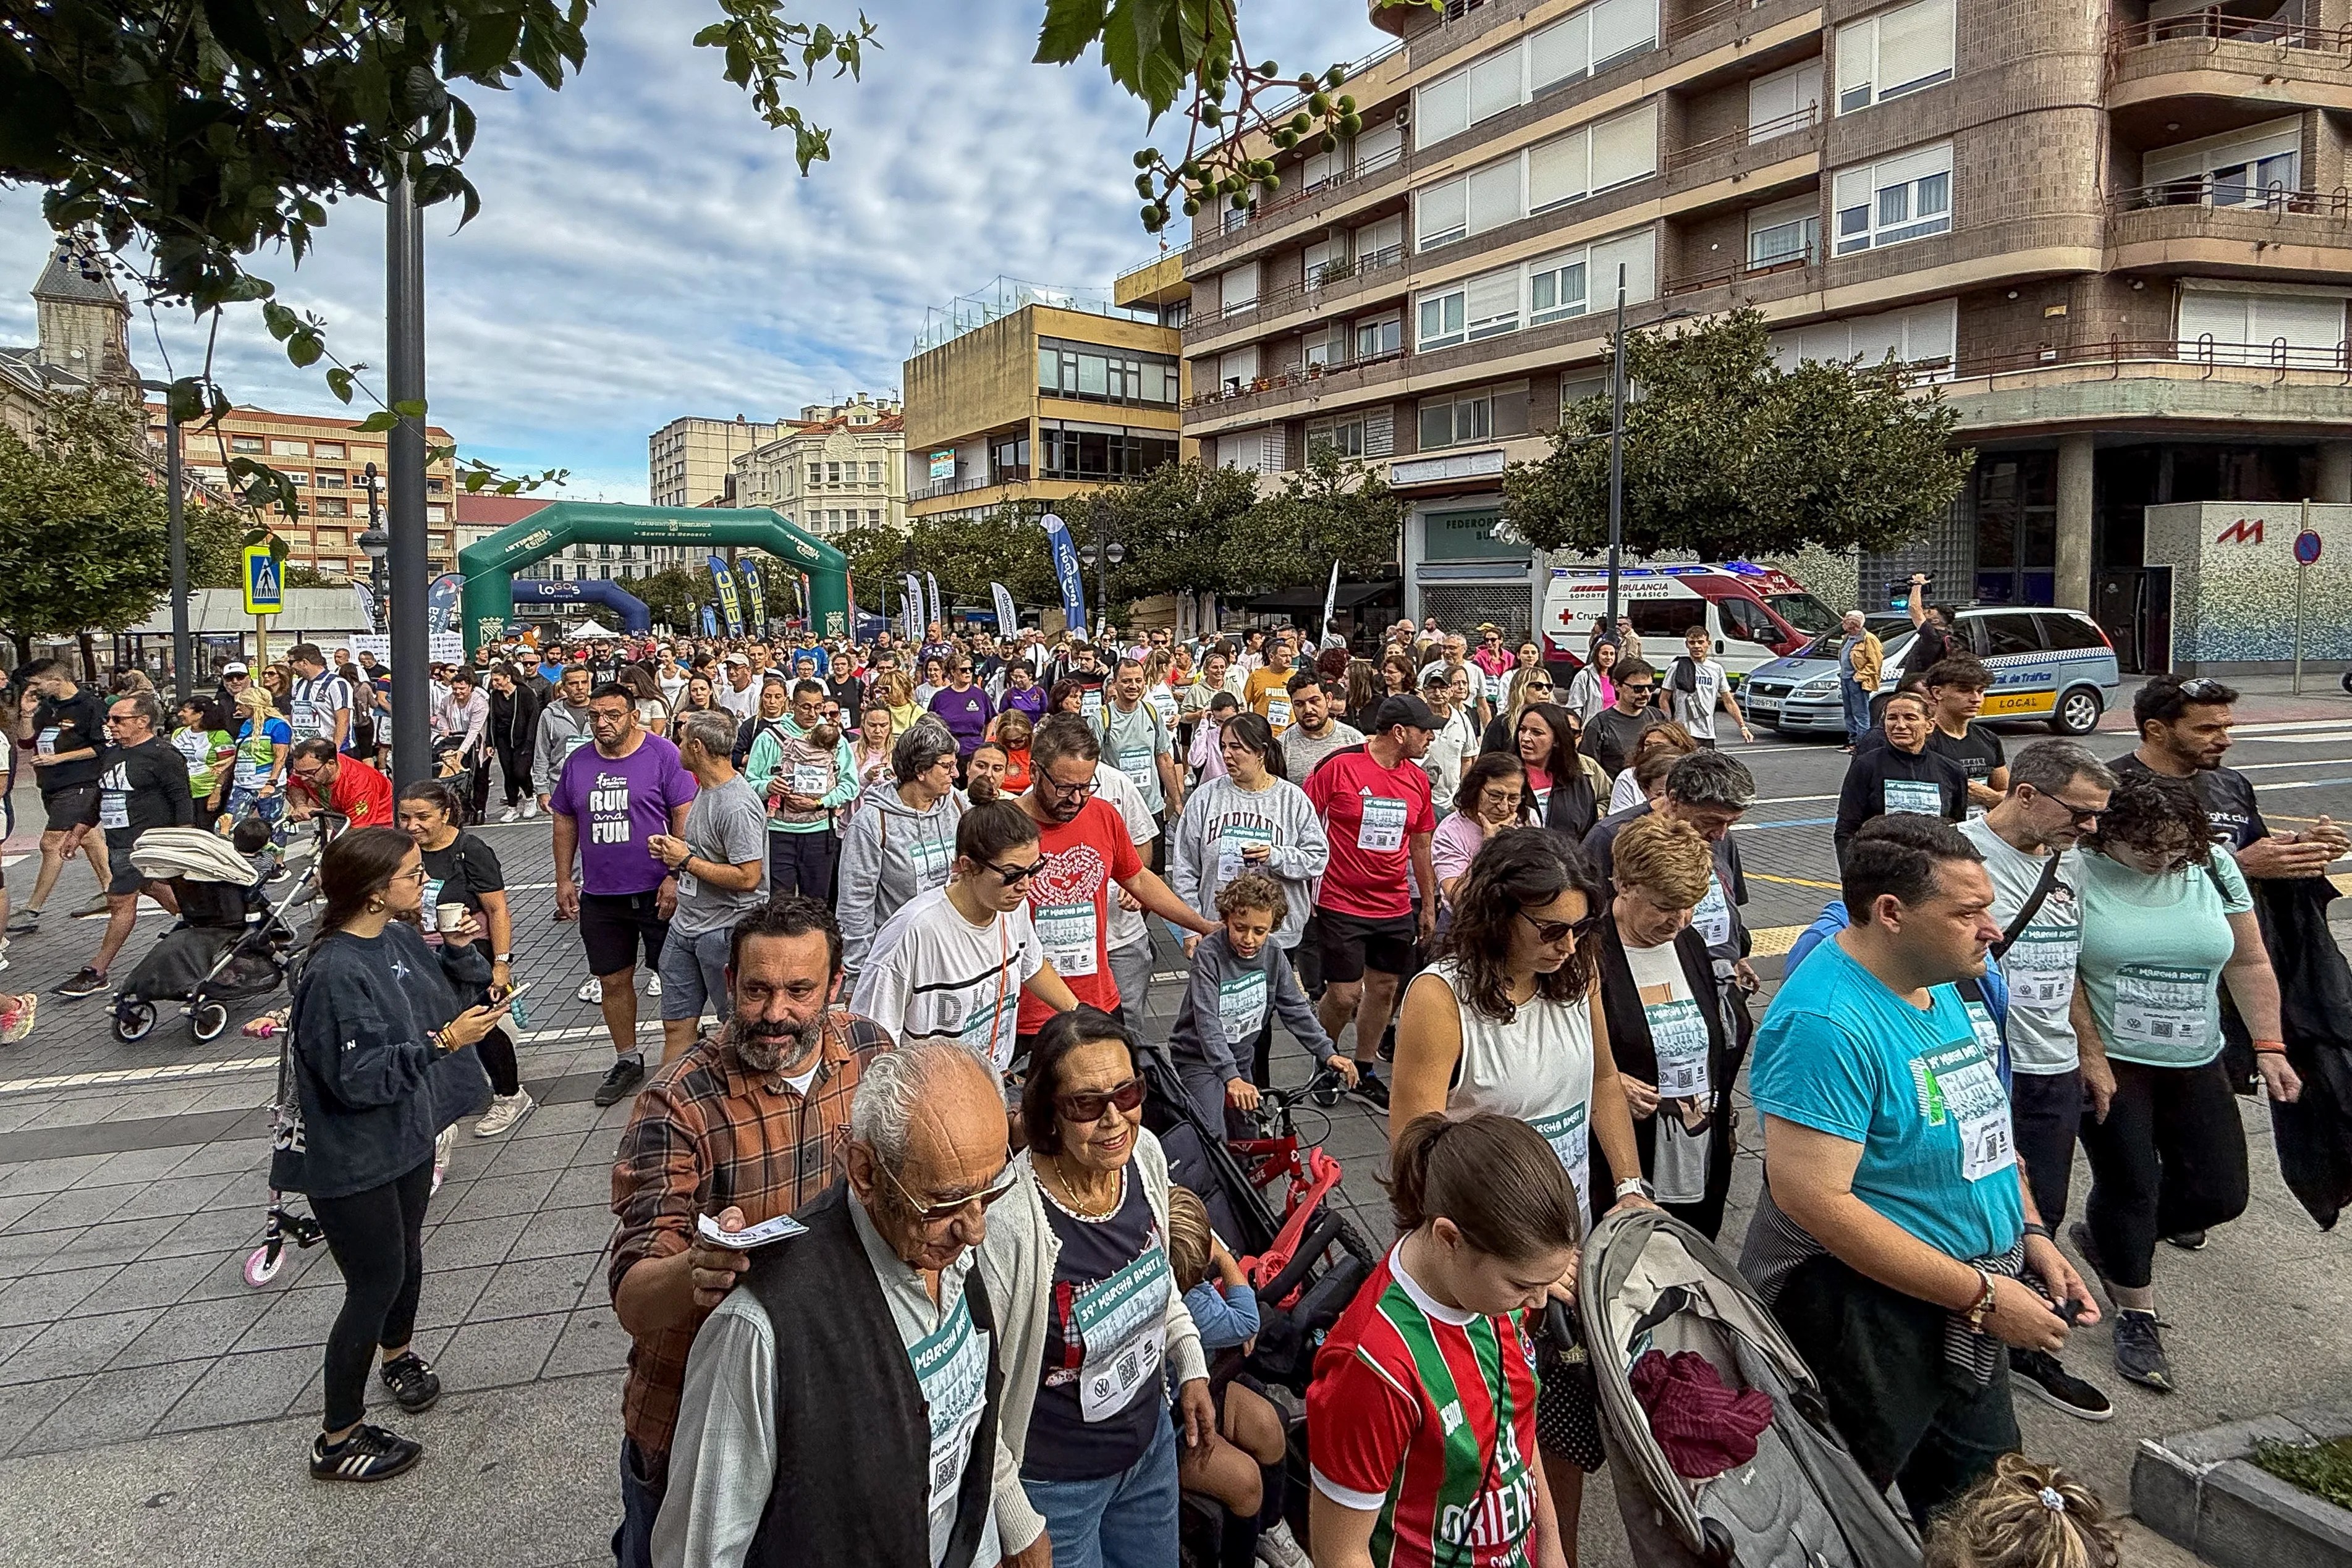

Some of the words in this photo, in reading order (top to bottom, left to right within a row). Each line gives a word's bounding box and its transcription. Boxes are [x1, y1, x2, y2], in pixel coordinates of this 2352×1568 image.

[1999, 698, 2037, 708] LOCAL
[590, 789, 629, 812] RUN
[594, 810, 624, 820] and
[592, 821, 630, 845] FUN
[1098, 1275, 1133, 1310] MARCHA
[915, 1327, 957, 1372] MARCHA
[1497, 1421, 1521, 1474] LA
